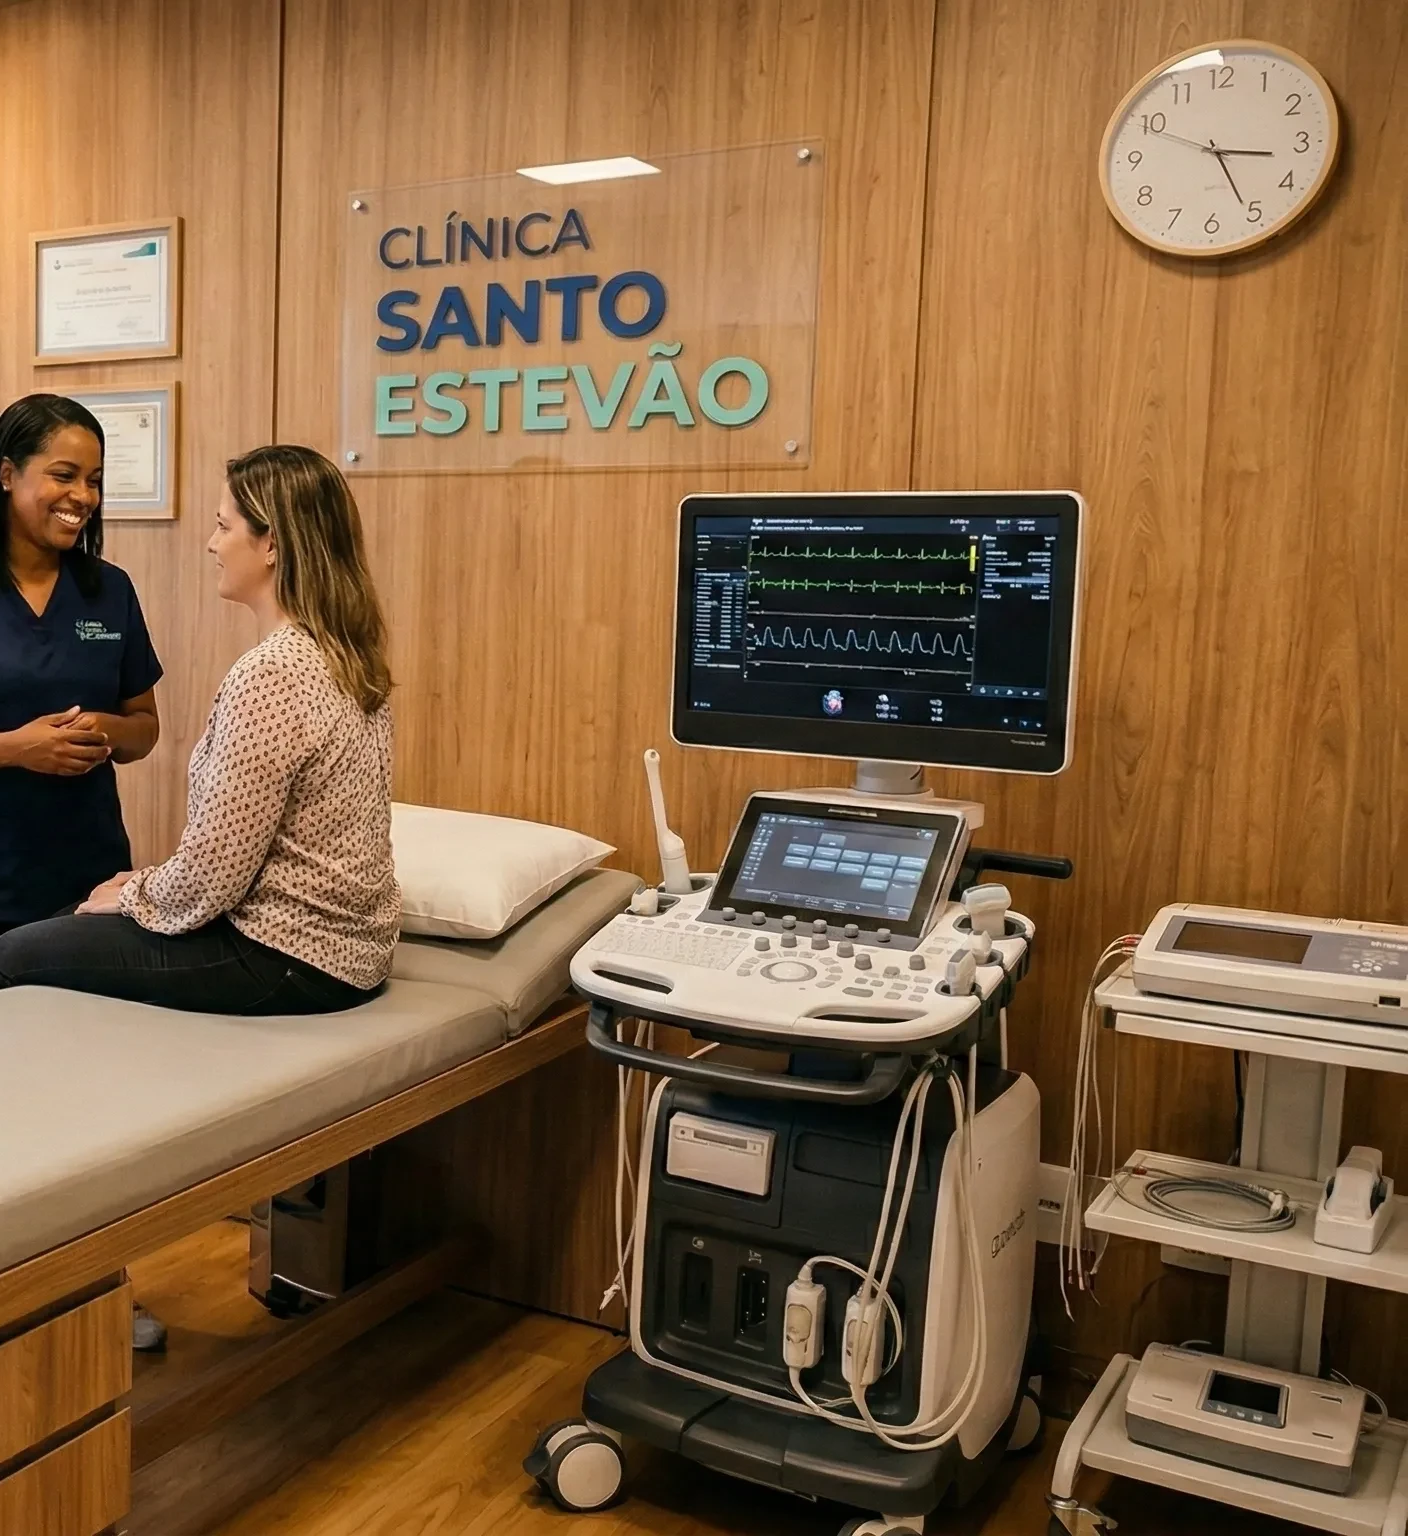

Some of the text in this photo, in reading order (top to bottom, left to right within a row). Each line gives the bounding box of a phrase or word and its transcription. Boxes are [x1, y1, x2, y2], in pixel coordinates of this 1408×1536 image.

[1209, 66, 1234, 90] 12
[1260, 71, 1267, 92] 1
[1172, 82, 1191, 105] 11
[1284, 93, 1301, 116] 2
[1141, 112, 1166, 135] 10
[1293, 131, 1310, 153] 3
[1127, 150, 1142, 171] 9
[1278, 169, 1294, 191] 4
[1137, 185, 1152, 206] 8
[1168, 208, 1182, 230] 7
[1246, 200, 1262, 222] 5
[1204, 213, 1220, 234] 6
[379, 208, 592, 270] CLÍNICA
[376, 270, 667, 352] SANTO
[375, 341, 769, 435] ESTEVÃO
